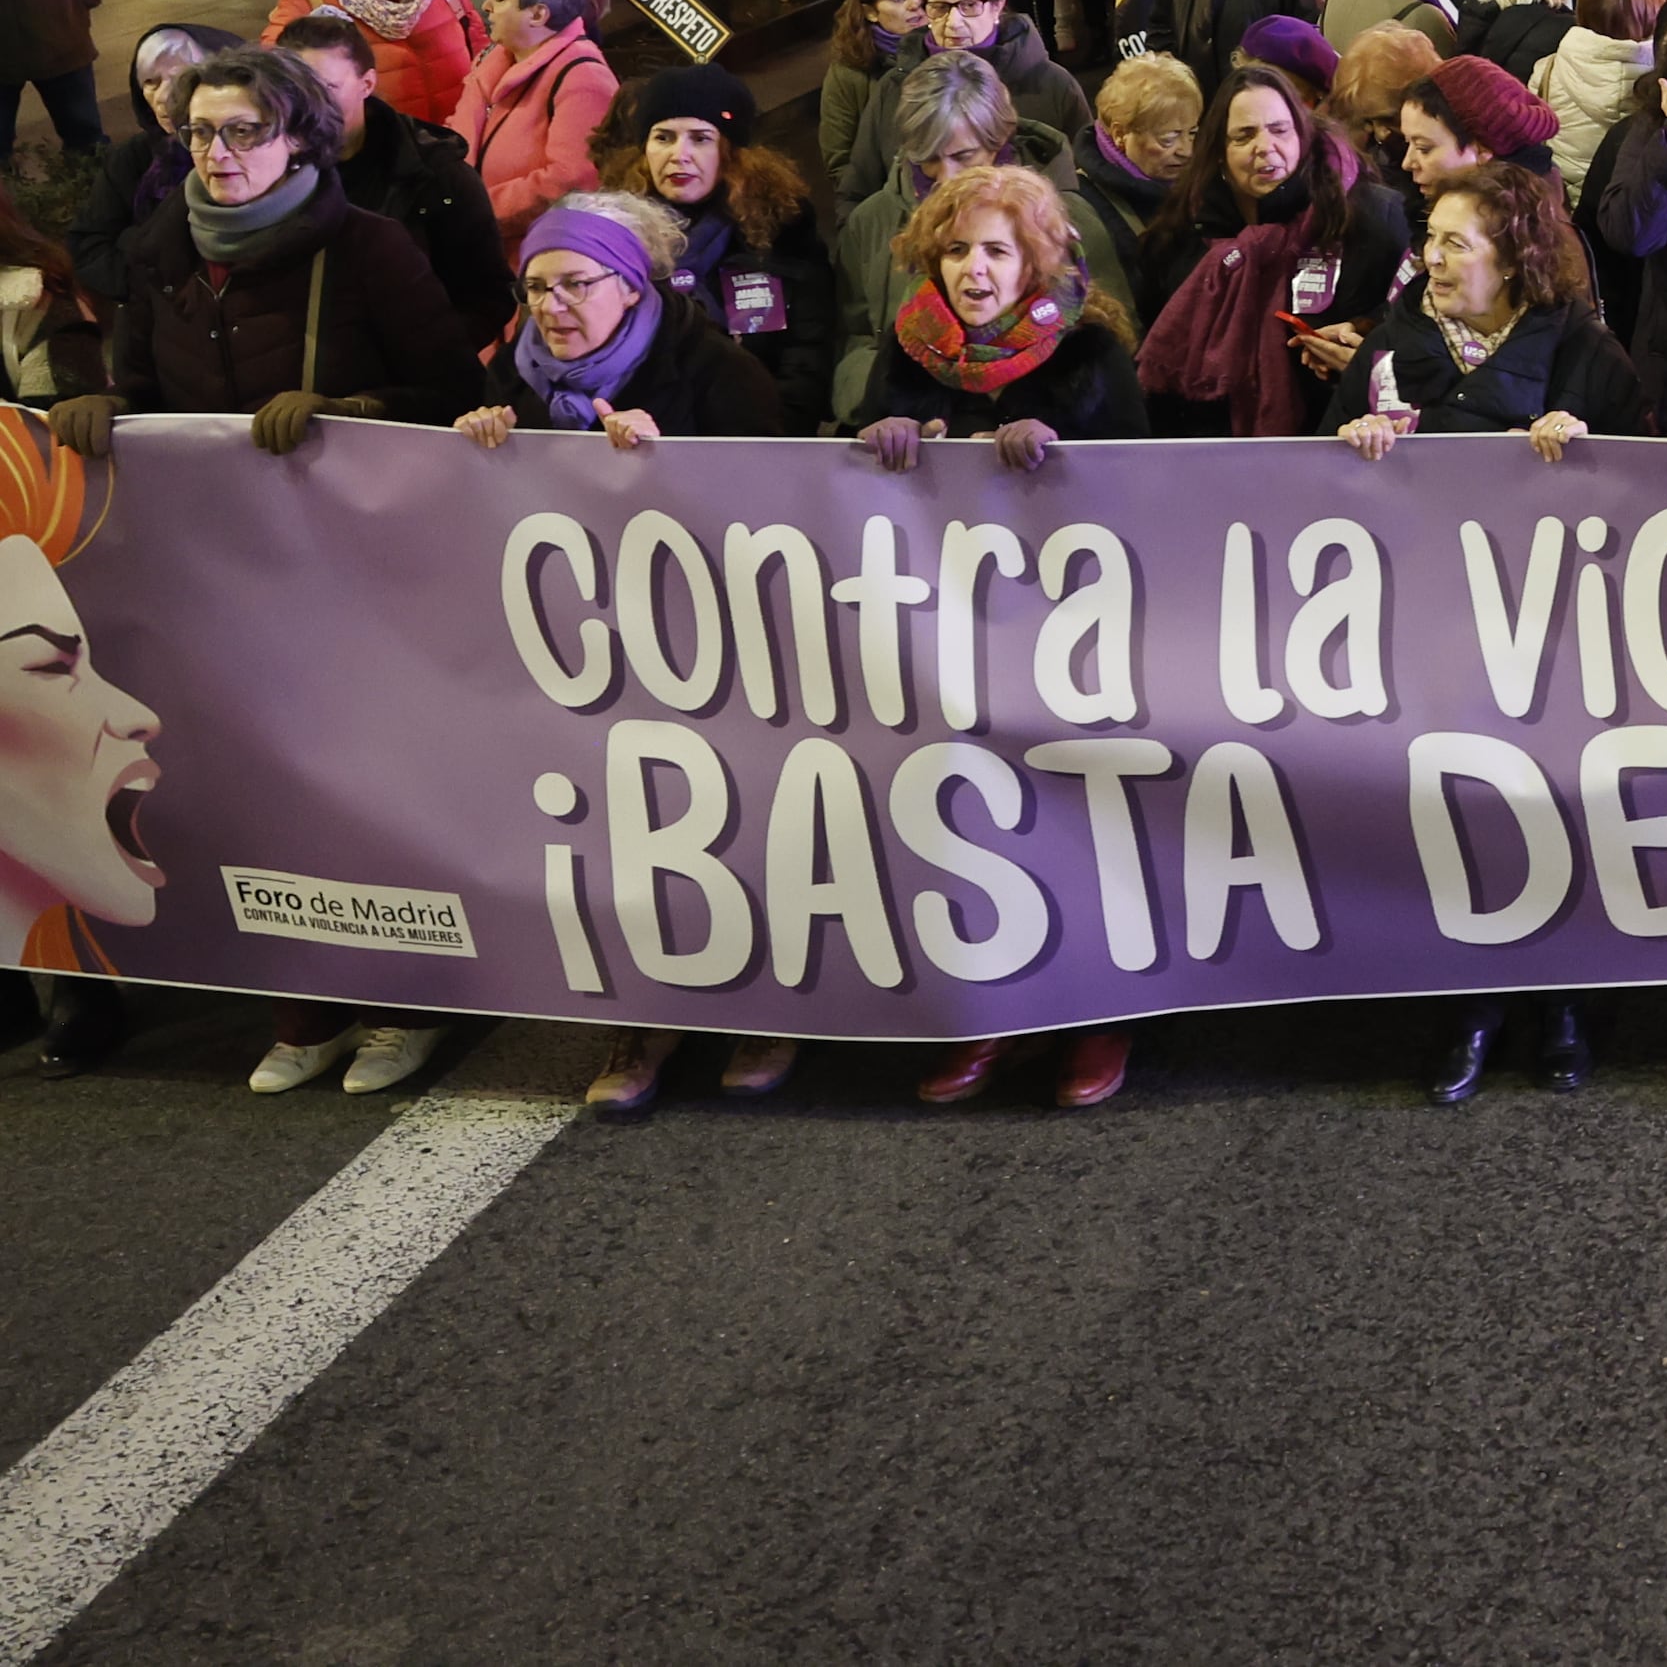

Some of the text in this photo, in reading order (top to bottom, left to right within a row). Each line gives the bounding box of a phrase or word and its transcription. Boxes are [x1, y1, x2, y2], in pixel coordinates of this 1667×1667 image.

[1219, 518, 1388, 724] la
[235, 880, 457, 928] Foro de Madrid
[243, 907, 463, 945] CONTRA LA VIOLENCIA A LAS MUJERES
